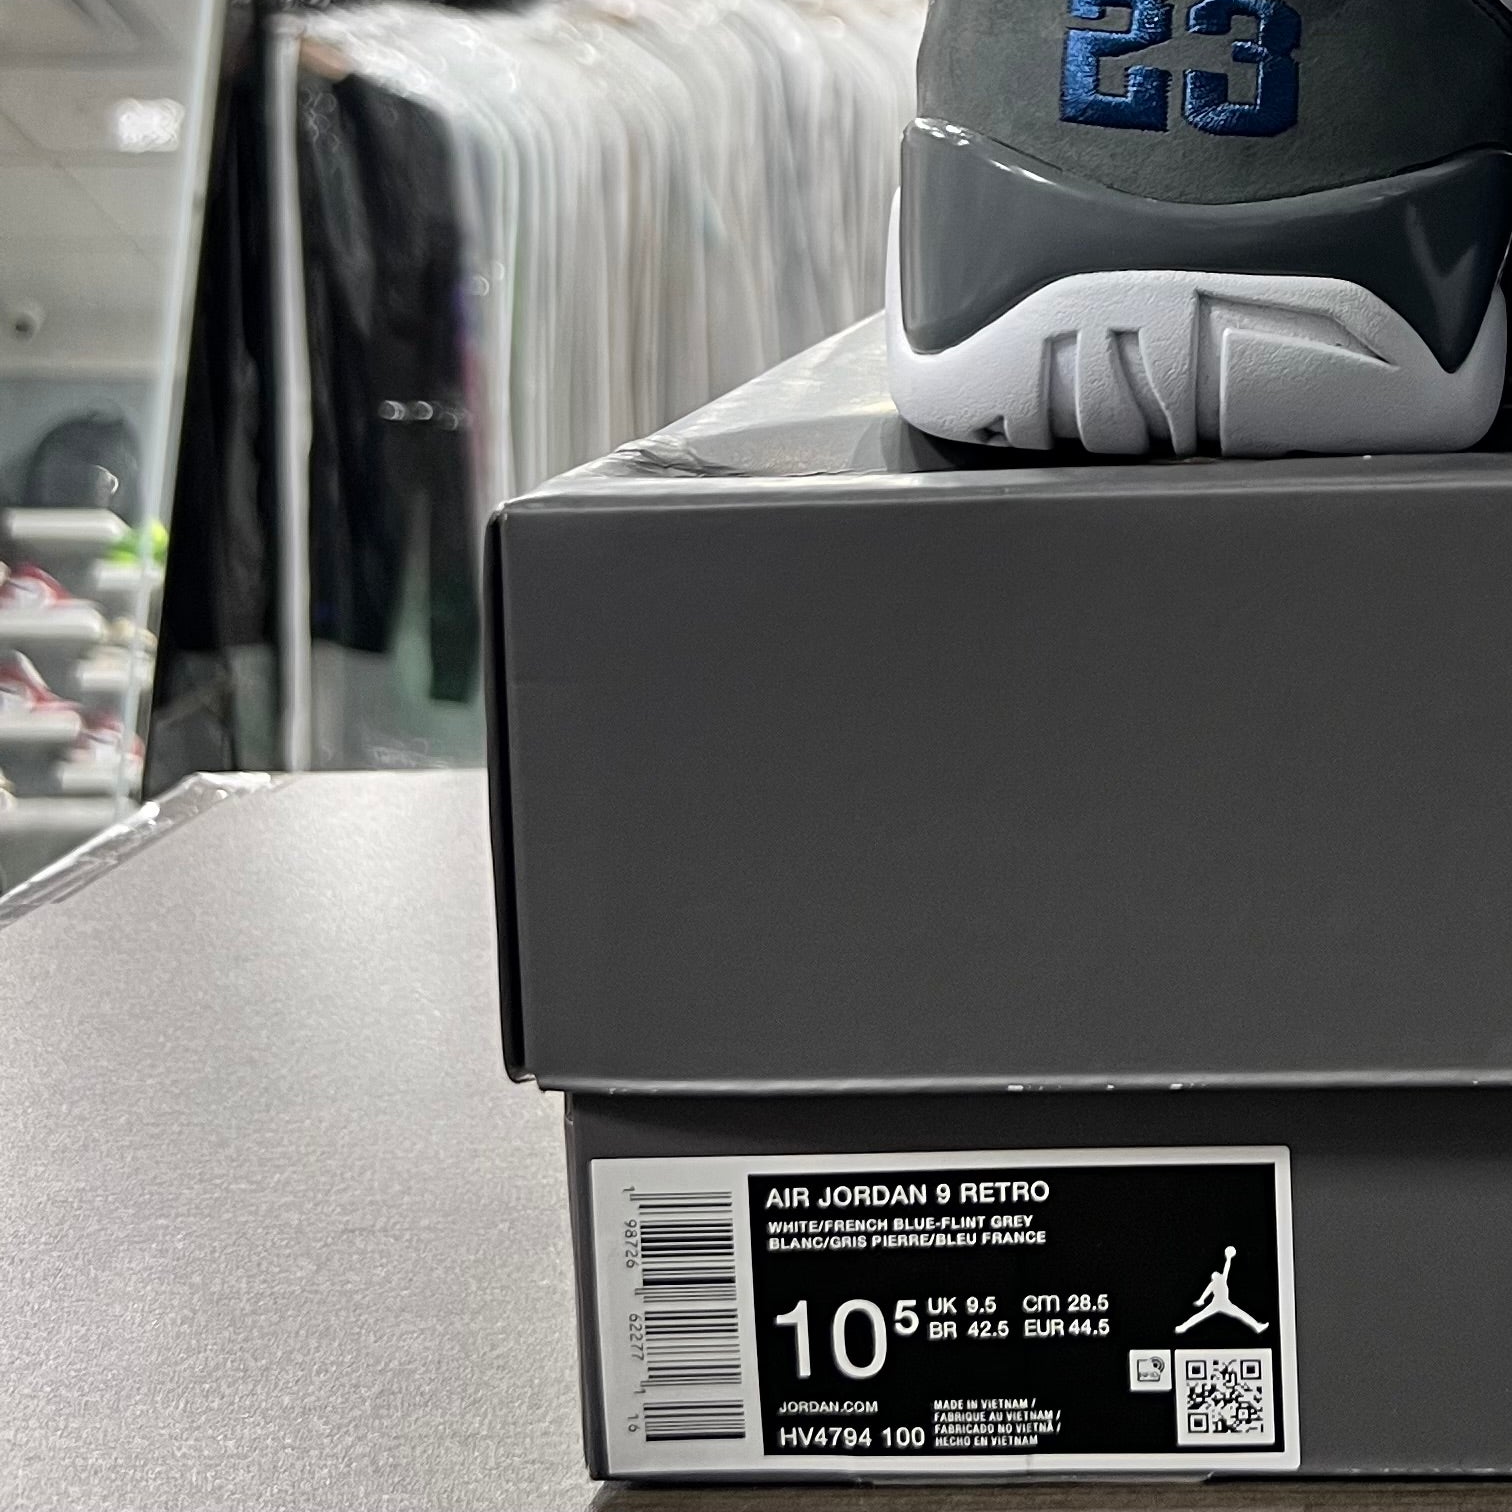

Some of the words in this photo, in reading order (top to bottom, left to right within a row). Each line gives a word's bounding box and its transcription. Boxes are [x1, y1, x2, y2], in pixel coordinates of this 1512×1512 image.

[765, 1187, 810, 1209] AIR
[817, 1184, 928, 1208] JORDAN
[936, 1183, 951, 1205] 9
[960, 1180, 1050, 1204] RETRO
[768, 1218, 888, 1234] WHITE/FRENCH
[893, 1215, 986, 1231] BLUE-FLINT
[990, 1214, 1034, 1229] GREY
[624, 1219, 638, 1269] 98726
[769, 1235, 867, 1250] BLANC/GRIS
[871, 1232, 977, 1248] PIERRE/BLEU
[982, 1230, 1047, 1245] FRANCE
[927, 1297, 957, 1315] UK
[966, 1296, 997, 1315] 9.5
[1067, 1293, 1110, 1312] 28.5
[628, 1313, 645, 1362] 62277
[928, 1321, 957, 1339] BR
[966, 1320, 1010, 1338] 42.5
[1023, 1318, 1065, 1338] EUR
[1068, 1317, 1110, 1337] 44.5
[778, 1401, 879, 1414] JORDAN.COM
[934, 1399, 964, 1410] MADE
[967, 1399, 978, 1409] IN
[981, 1398, 1028, 1409] VIETNAM
[627, 1413, 640, 1433] 16
[934, 1411, 986, 1422] FABRIQUE
[988, 1411, 1003, 1422] AU
[1006, 1410, 1053, 1421] VIETNAM
[780, 1426, 872, 1448] HV4794
[881, 1426, 925, 1447] 100
[934, 1423, 995, 1434] FABRICADO
[997, 1423, 1013, 1434] NO
[935, 1436, 971, 1447] HECHO
[973, 1436, 988, 1446] EN
[991, 1435, 1038, 1446] VIETNAM
